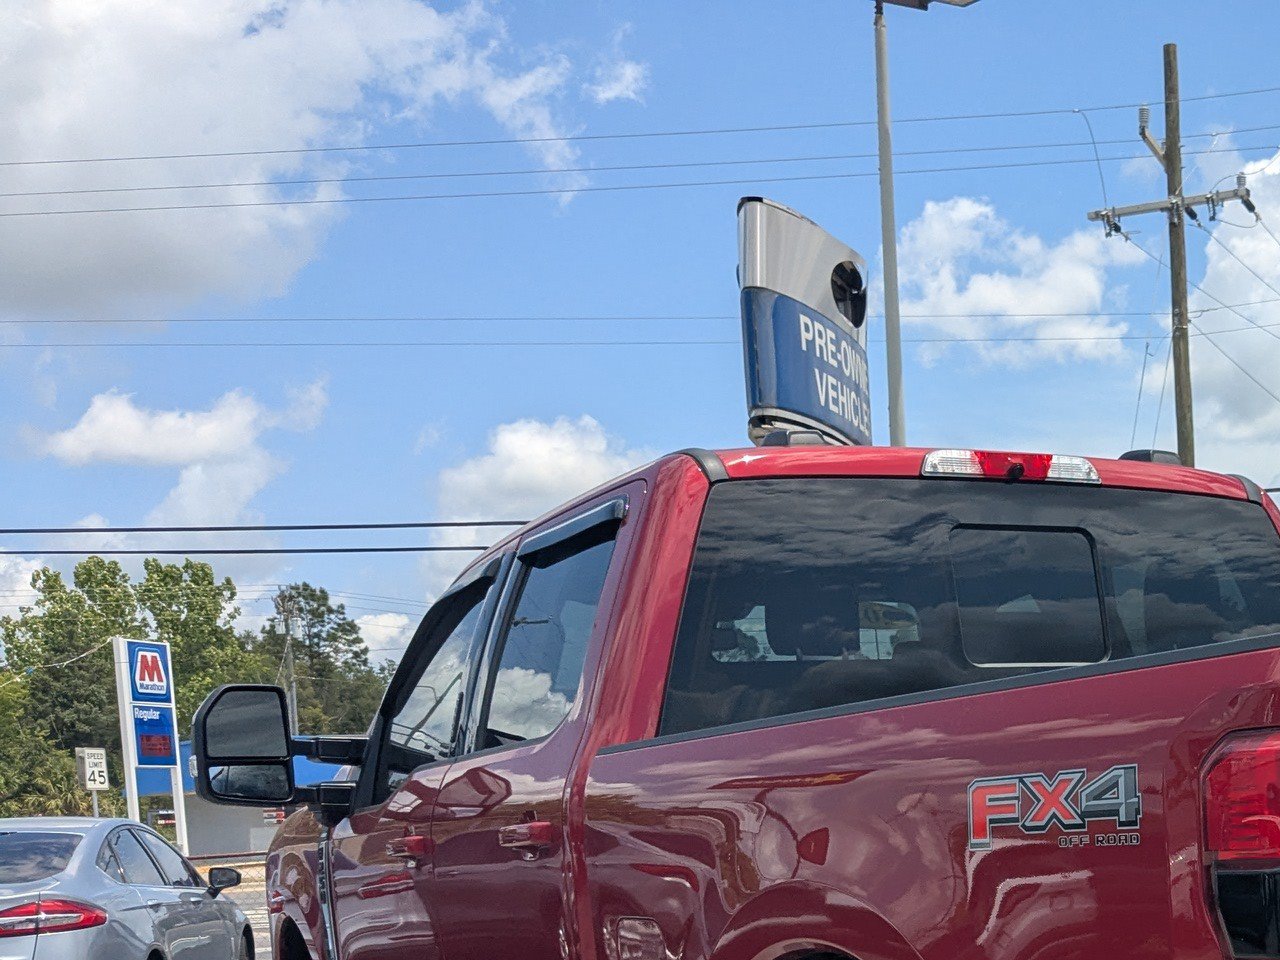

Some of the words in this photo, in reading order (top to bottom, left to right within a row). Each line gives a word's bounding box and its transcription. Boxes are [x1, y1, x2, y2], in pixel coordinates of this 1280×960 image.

[814, 367, 870, 437] VEHICLE
[139, 682, 165, 691] Marathon
[134, 707, 160, 721] Regular
[86, 752, 104, 760] SPEED
[88, 761, 103, 769] LIMIT
[87, 770, 106, 785] 45
[967, 763, 1143, 852] FX4
[1058, 834, 1090, 848] OFF
[1095, 832, 1141, 847] ROAD
